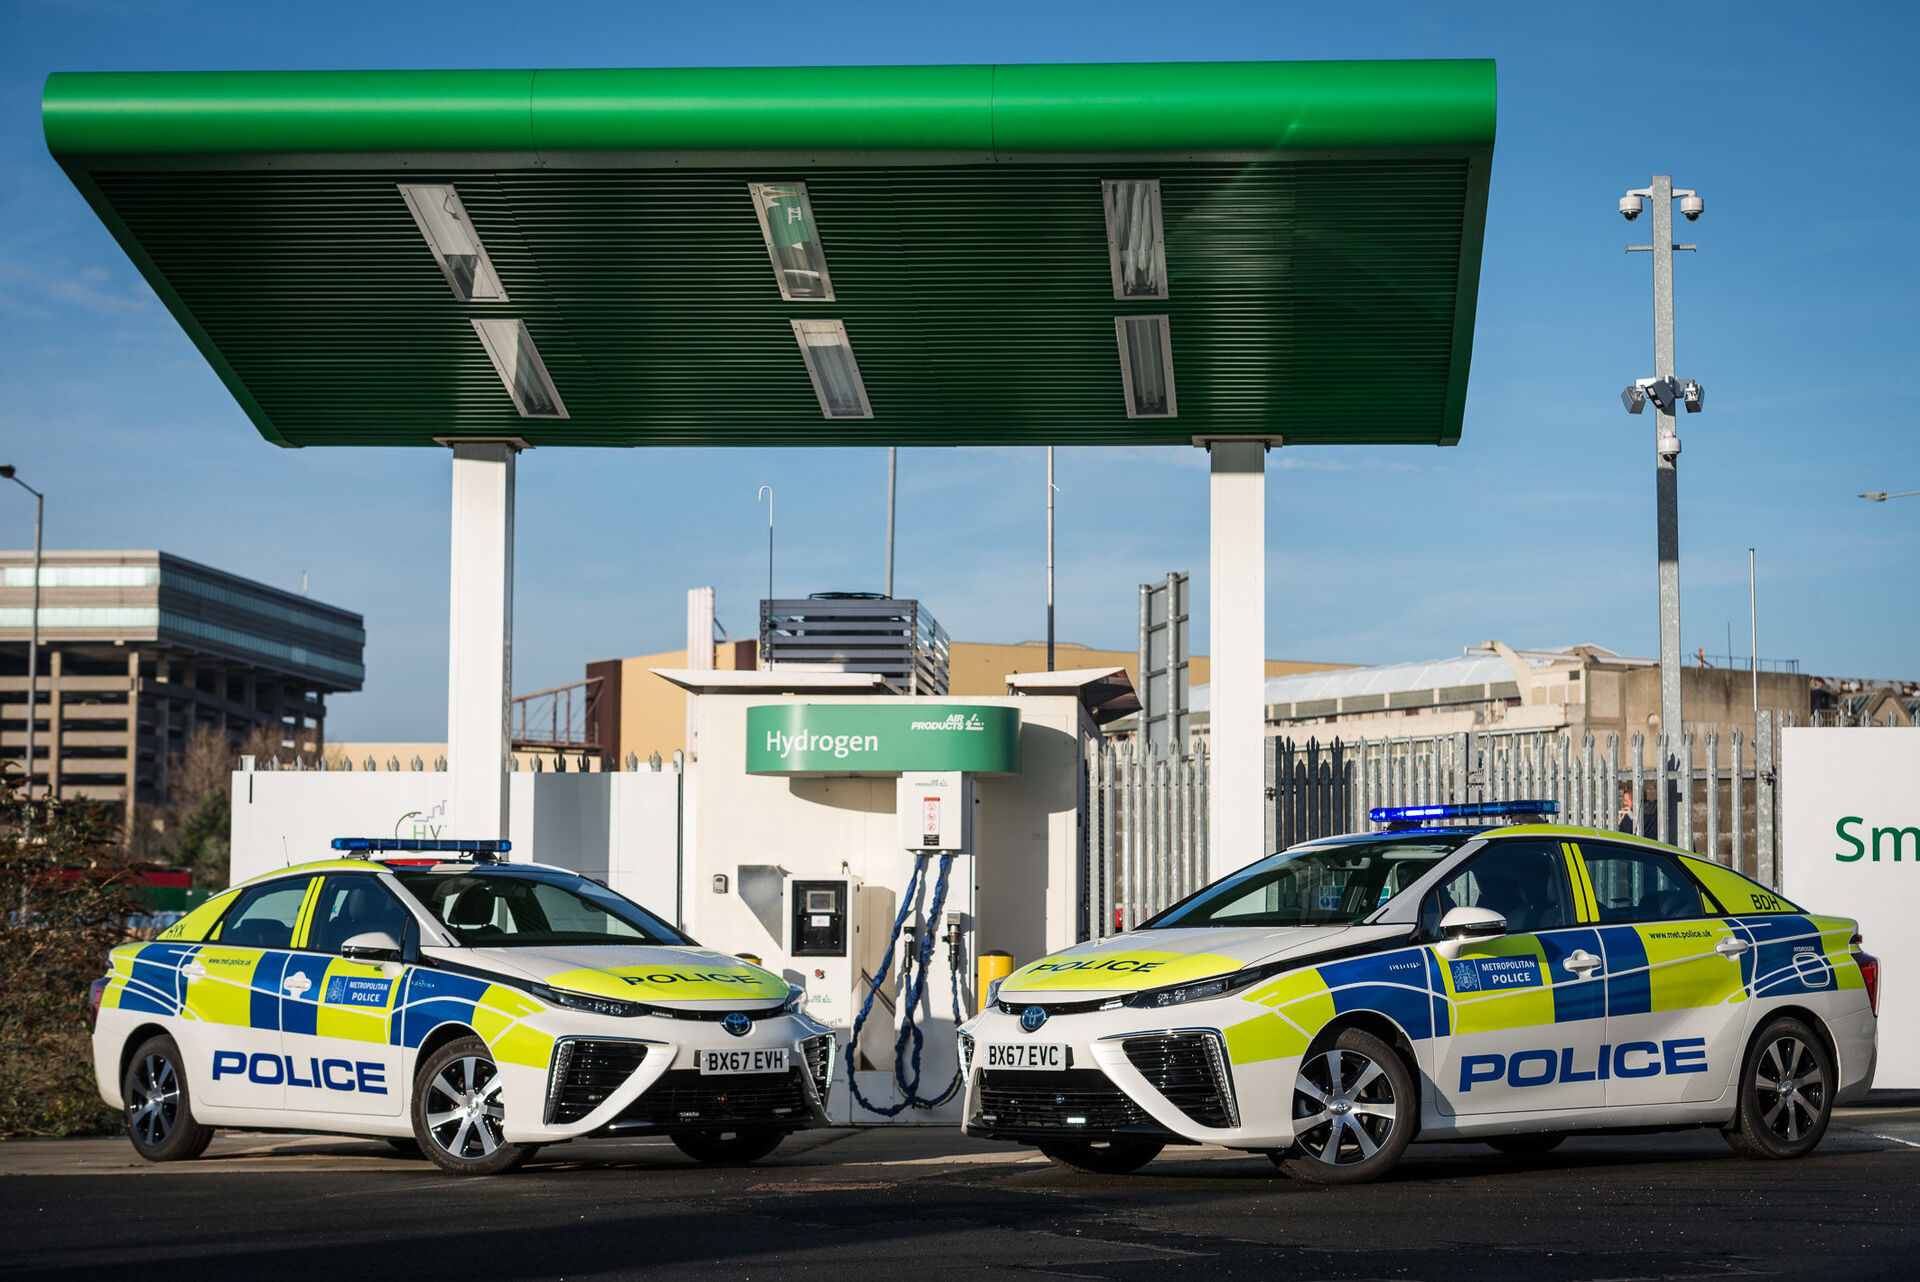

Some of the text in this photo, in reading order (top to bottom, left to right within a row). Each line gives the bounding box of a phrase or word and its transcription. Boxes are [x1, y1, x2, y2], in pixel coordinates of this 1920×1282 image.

[945, 714, 964, 722] AIR
[911, 722, 964, 730] PRODUCTS
[766, 731, 879, 758] Hydrogen
[1750, 894, 1781, 911] BDH
[1649, 930, 1712, 940] www.met.police.uk
[1027, 960, 1166, 974] POLICE
[1481, 960, 1536, 972] METROPOLITAN
[620, 971, 762, 986] POLICE
[1492, 972, 1531, 985] POLICE
[349, 980, 388, 992] METROPOLITAN
[351, 992, 380, 1002] POLICE
[708, 1050, 783, 1071] BX67 EVH
[988, 1046, 1059, 1066] BX67 EVC
[1459, 1037, 1708, 1093] POLICE
[212, 1050, 388, 1095] POLICE
